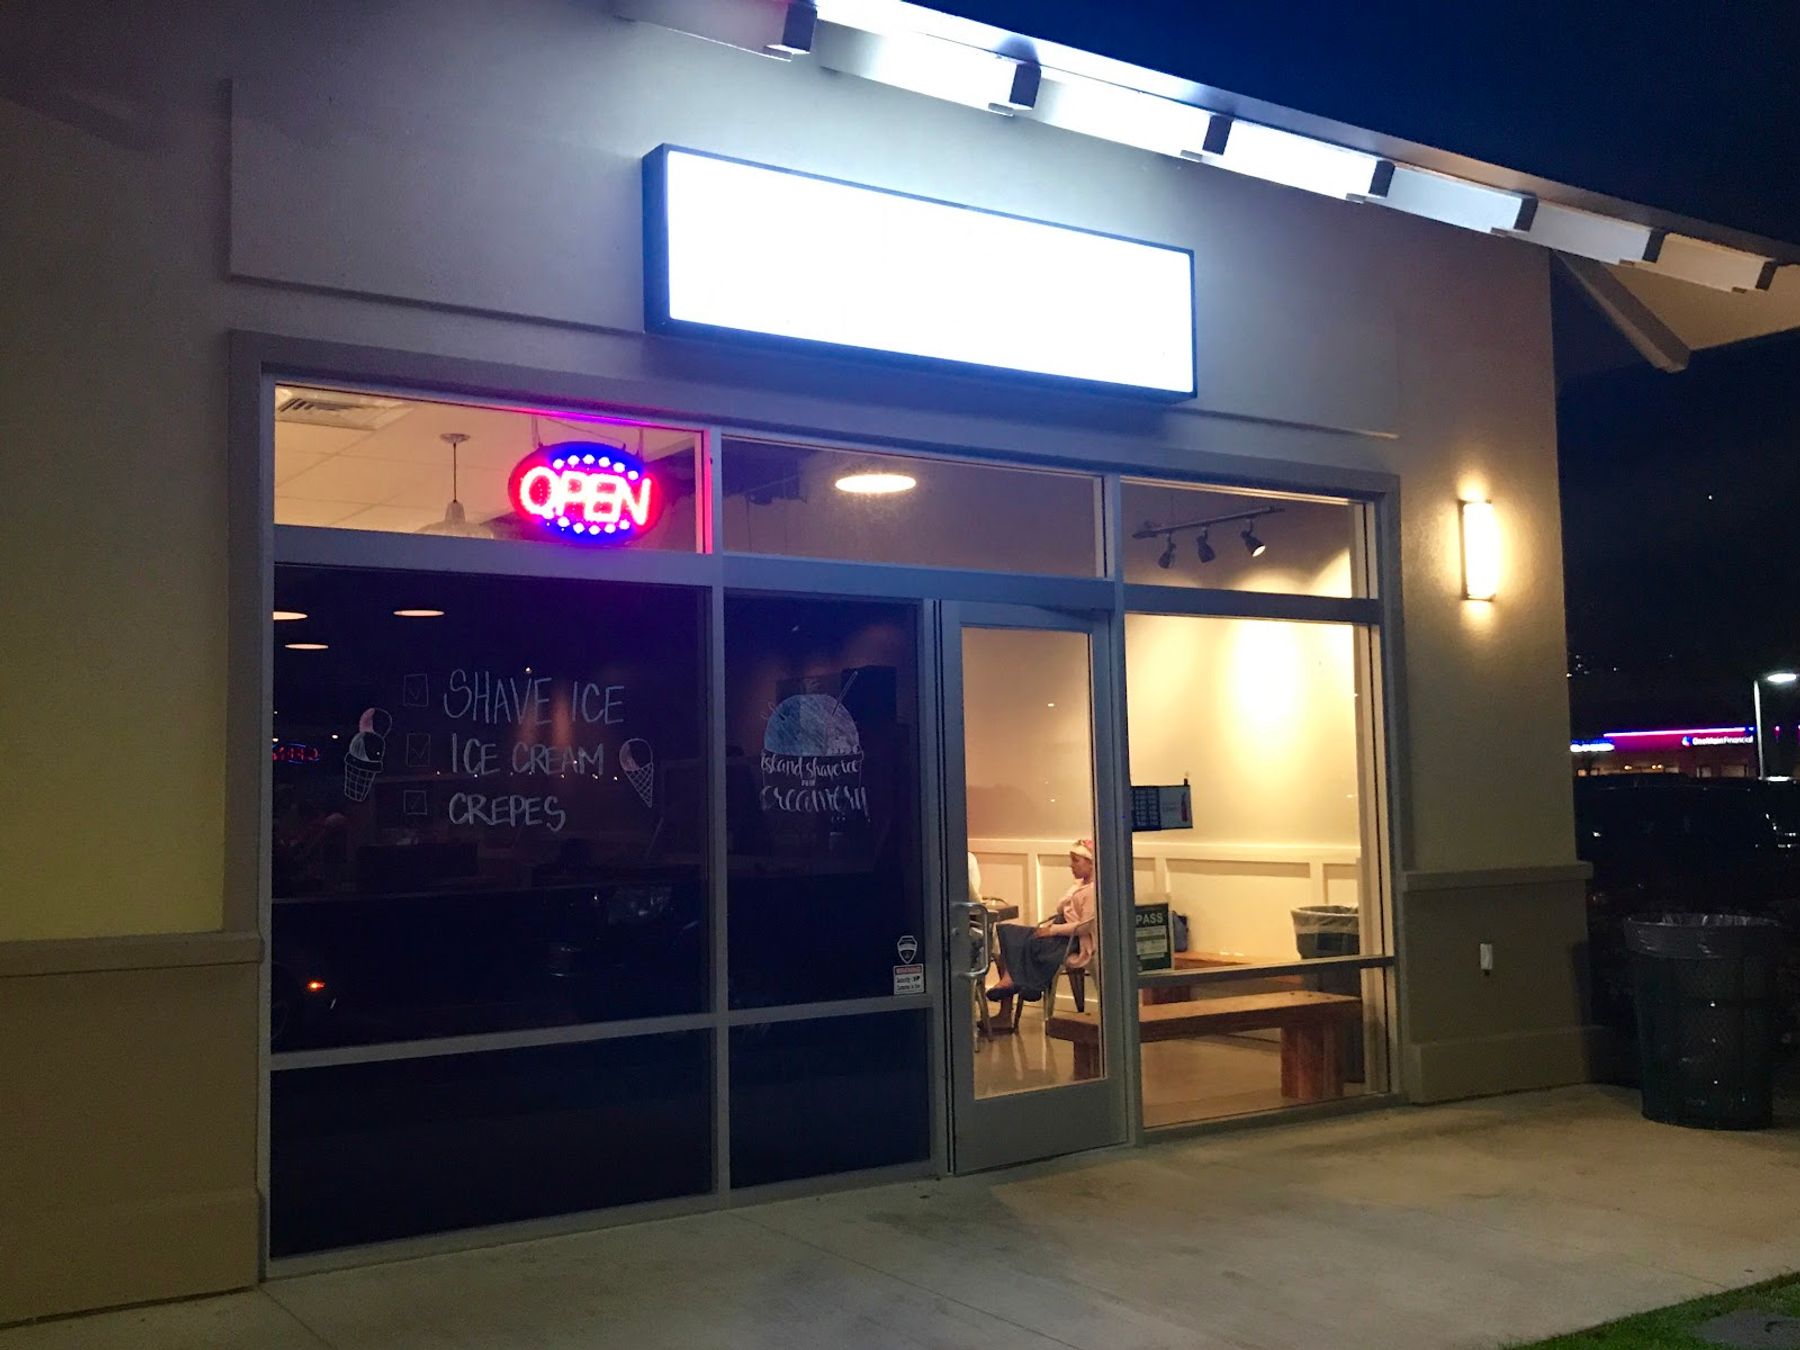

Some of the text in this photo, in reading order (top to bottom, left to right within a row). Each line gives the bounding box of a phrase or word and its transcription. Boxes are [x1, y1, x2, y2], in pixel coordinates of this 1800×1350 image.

[520, 466, 652, 526] OPEN
[444, 669, 625, 725] SHAVE ICE
[452, 733, 604, 776] ICE CREAM
[449, 792, 566, 831] CREPES
[1135, 912, 1164, 926] PASS
